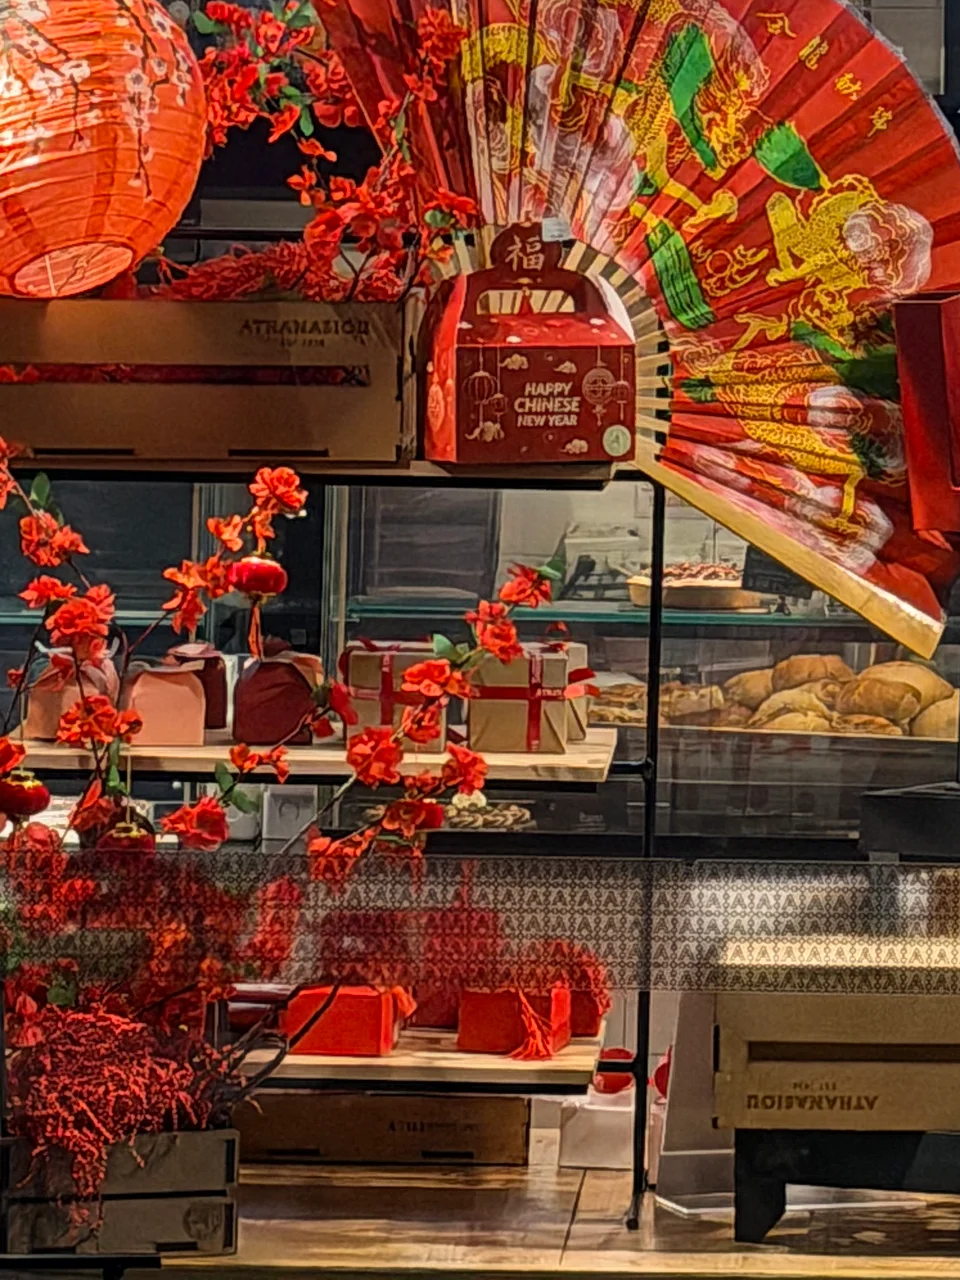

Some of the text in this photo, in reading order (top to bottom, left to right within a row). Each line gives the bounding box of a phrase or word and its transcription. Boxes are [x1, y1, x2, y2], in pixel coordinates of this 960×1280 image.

[504, 233, 546, 272] 福
[524, 380, 574, 397] HAPPY
[513, 396, 582, 413] CHINESE
[517, 413, 578, 428] NEW YEAR
[745, 1093, 880, 1112] ATHANASIOU
